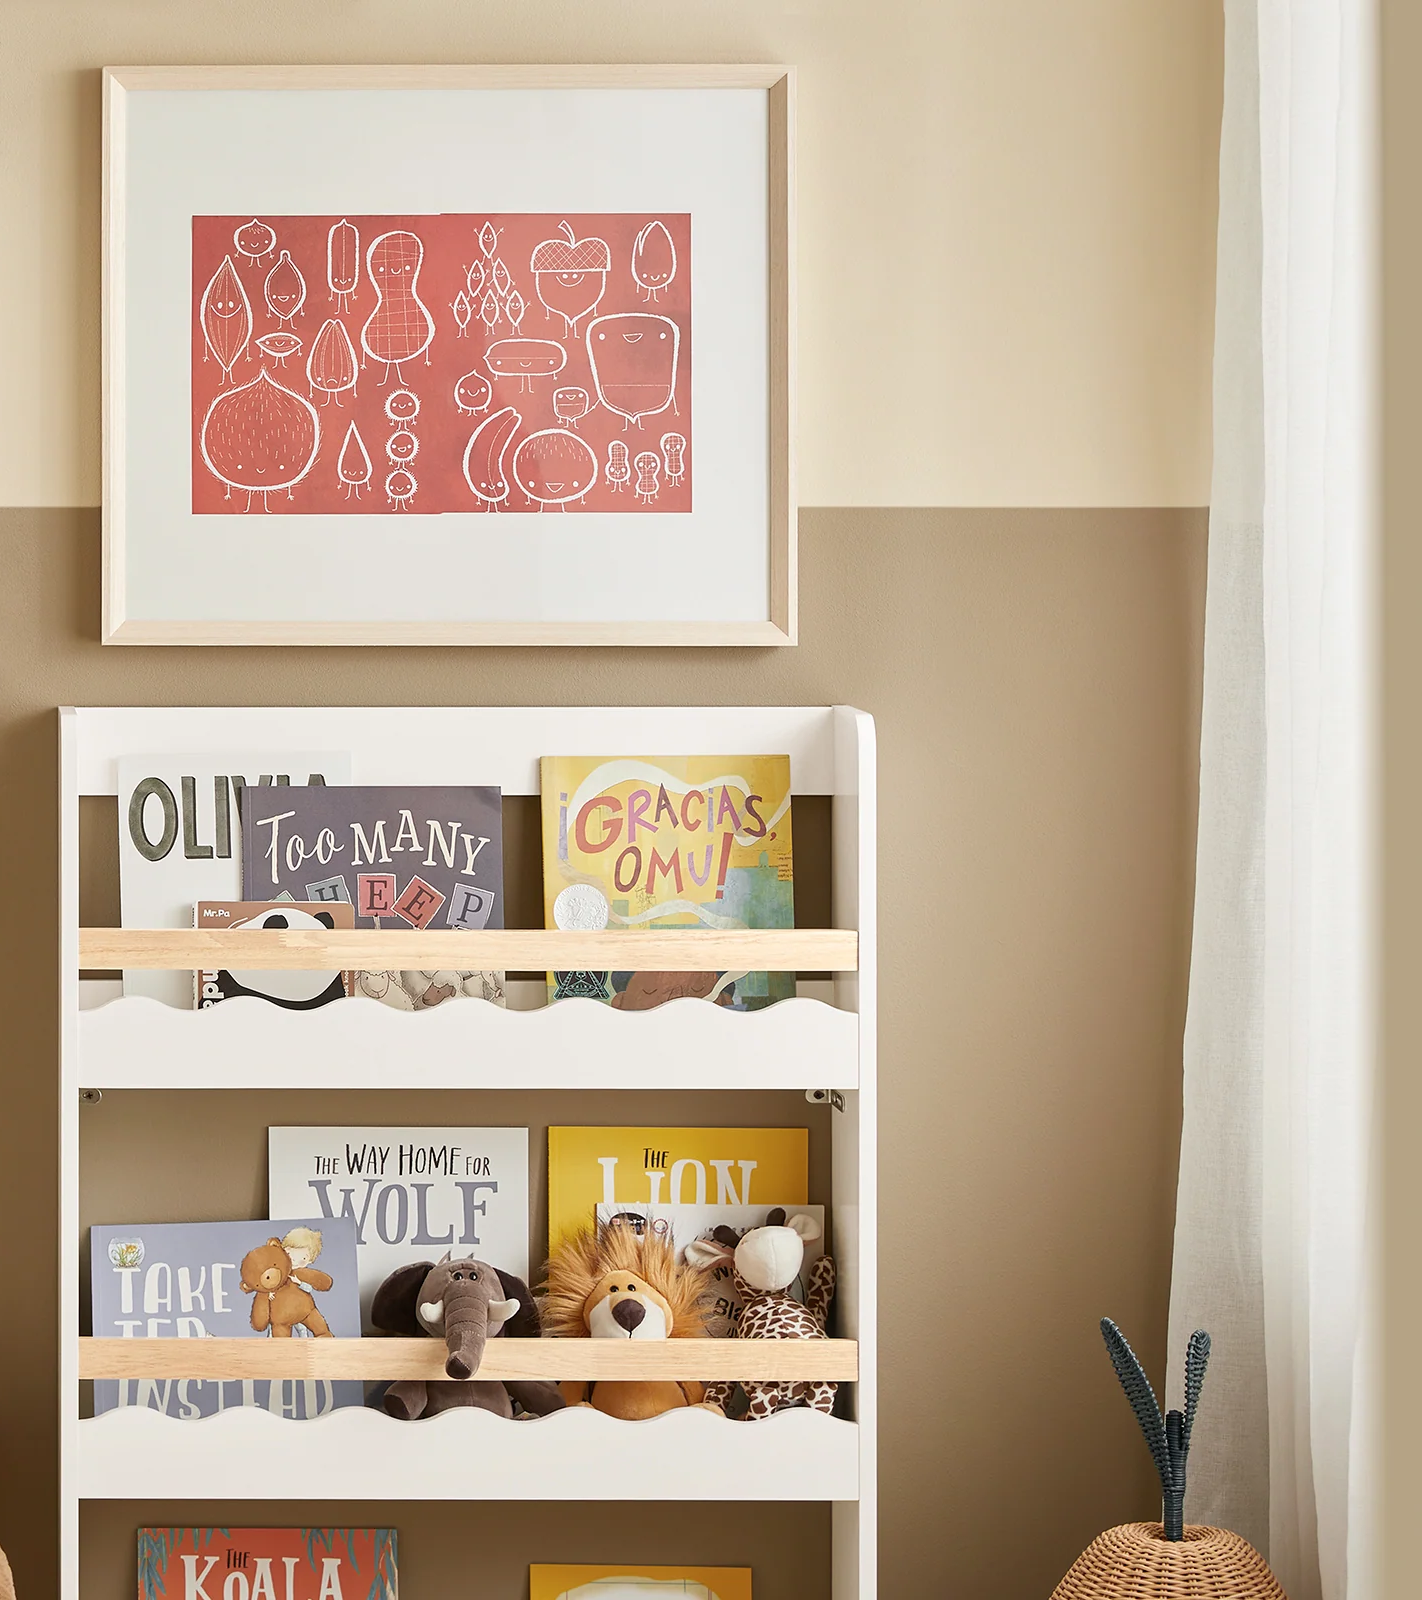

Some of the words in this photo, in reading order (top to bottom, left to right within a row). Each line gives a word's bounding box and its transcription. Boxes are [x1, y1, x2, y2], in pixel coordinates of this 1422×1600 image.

[128, 773, 328, 863] OLI
[256, 810, 345, 884] Too
[350, 809, 491, 876] MANY
[613, 832, 735, 900] OMU!
[314, 879, 484, 923] HEEP
[314, 1154, 339, 1176] THE
[345, 1143, 391, 1176] WAY
[398, 1143, 463, 1177] HOME
[466, 1156, 491, 1176] FOR
[642, 1147, 670, 1169] THE
[307, 1178, 498, 1247] WOLF
[112, 1262, 235, 1314] TAKE
[180, 1554, 344, 1600] KOALA
[225, 1548, 251, 1569] THE
